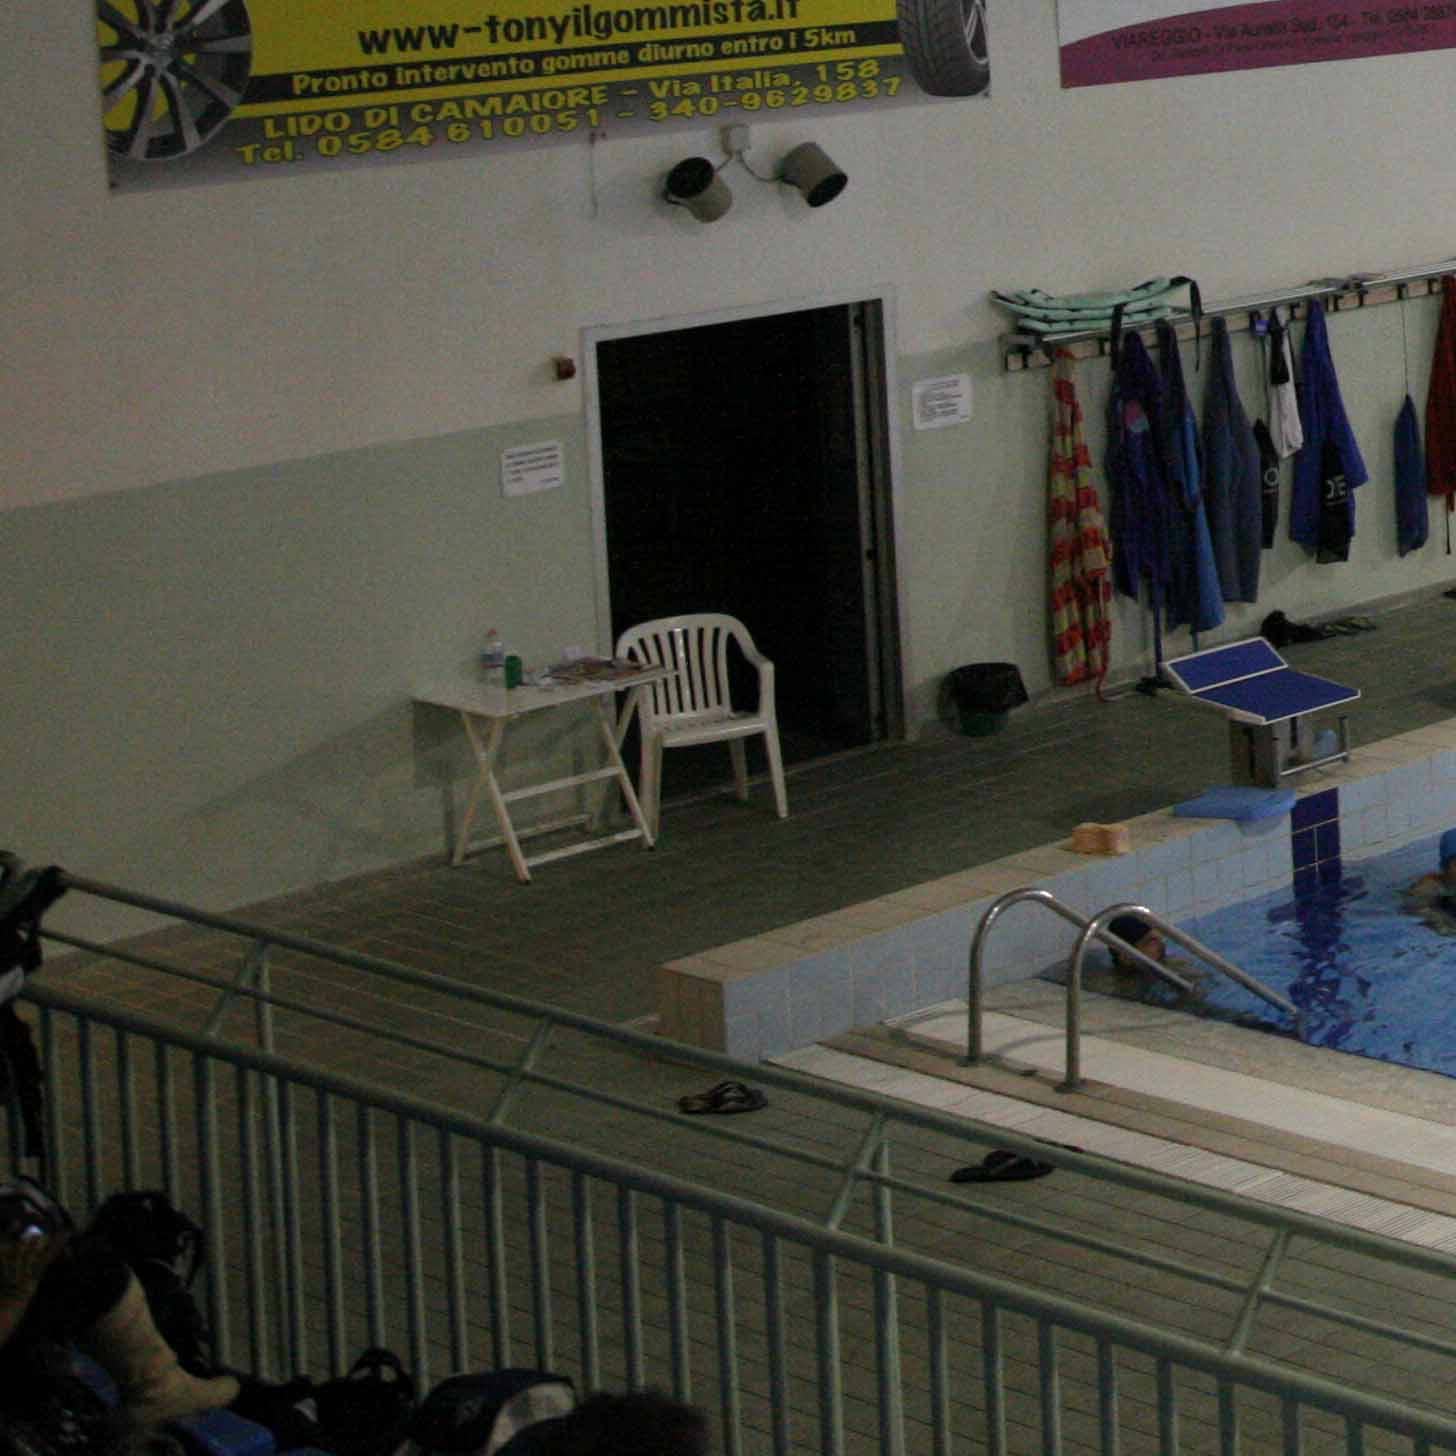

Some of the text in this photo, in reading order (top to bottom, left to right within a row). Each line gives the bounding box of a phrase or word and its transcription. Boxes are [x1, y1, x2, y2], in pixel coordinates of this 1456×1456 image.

[263, 111, 351, 139] LIDO
[363, 107, 399, 130] DI
[411, 86, 608, 123] CAMAIORE
[650, 78, 700, 99] Via
[709, 70, 802, 94] Italia,
[816, 59, 881, 84] 158
[292, 69, 388, 94] Pronto
[396, 53, 534, 88] intervento
[542, 48, 629, 80] gomme
[637, 42, 714, 64] diurno
[720, 30, 783, 56] entro
[803, 26, 856, 49] 5km
[237, 141, 305, 166] Tel.
[316, 125, 435, 157] 0584
[446, 108, 600, 144] 610051
[649, 75, 903, 122] 340-9629837
